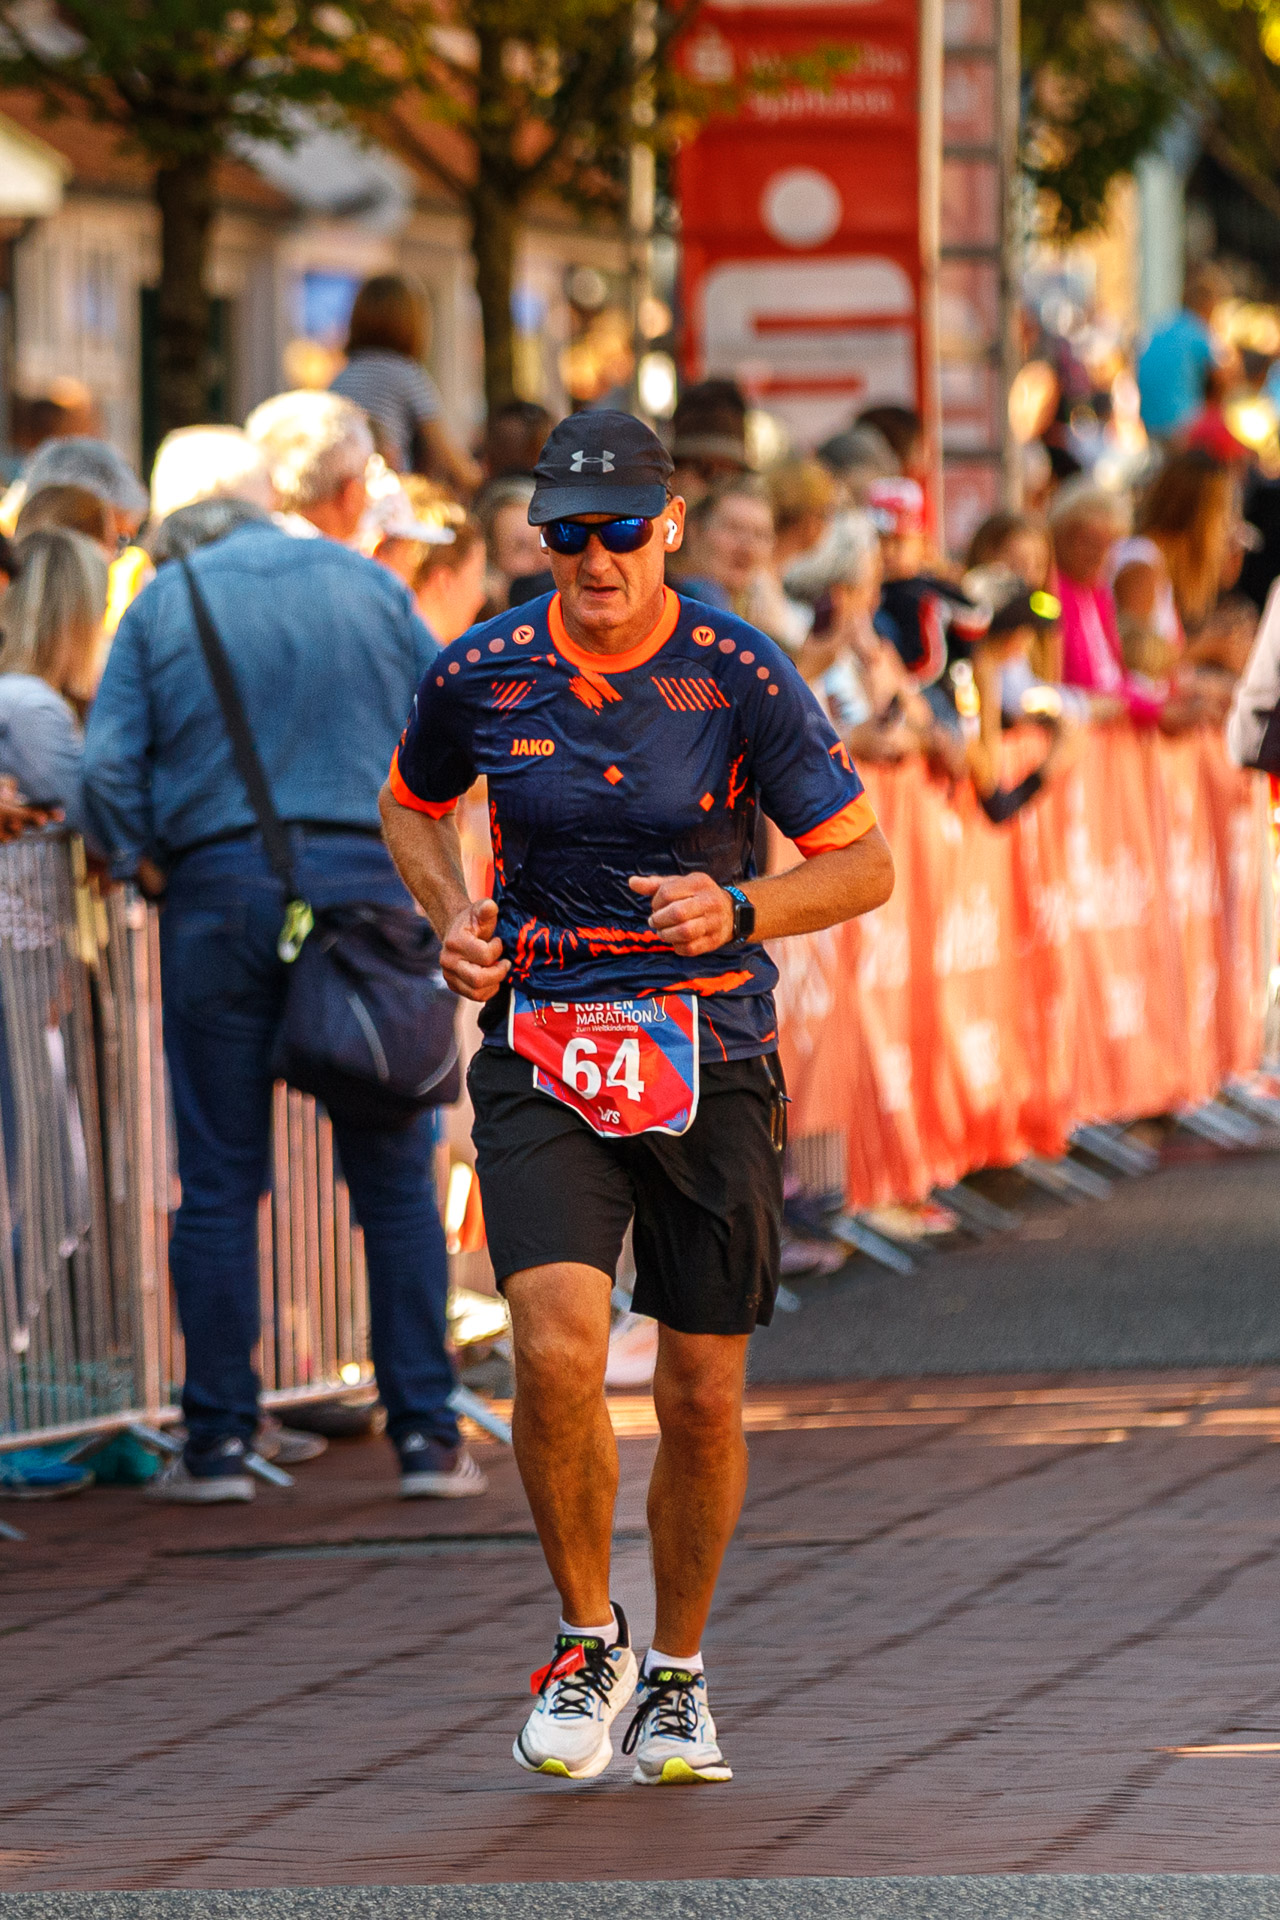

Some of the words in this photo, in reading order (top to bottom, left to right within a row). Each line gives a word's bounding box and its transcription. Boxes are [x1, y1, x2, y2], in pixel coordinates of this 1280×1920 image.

[510, 738, 555, 756] JAKO
[576, 1010, 652, 1025] MARATHON
[562, 1037, 644, 1102] 64
